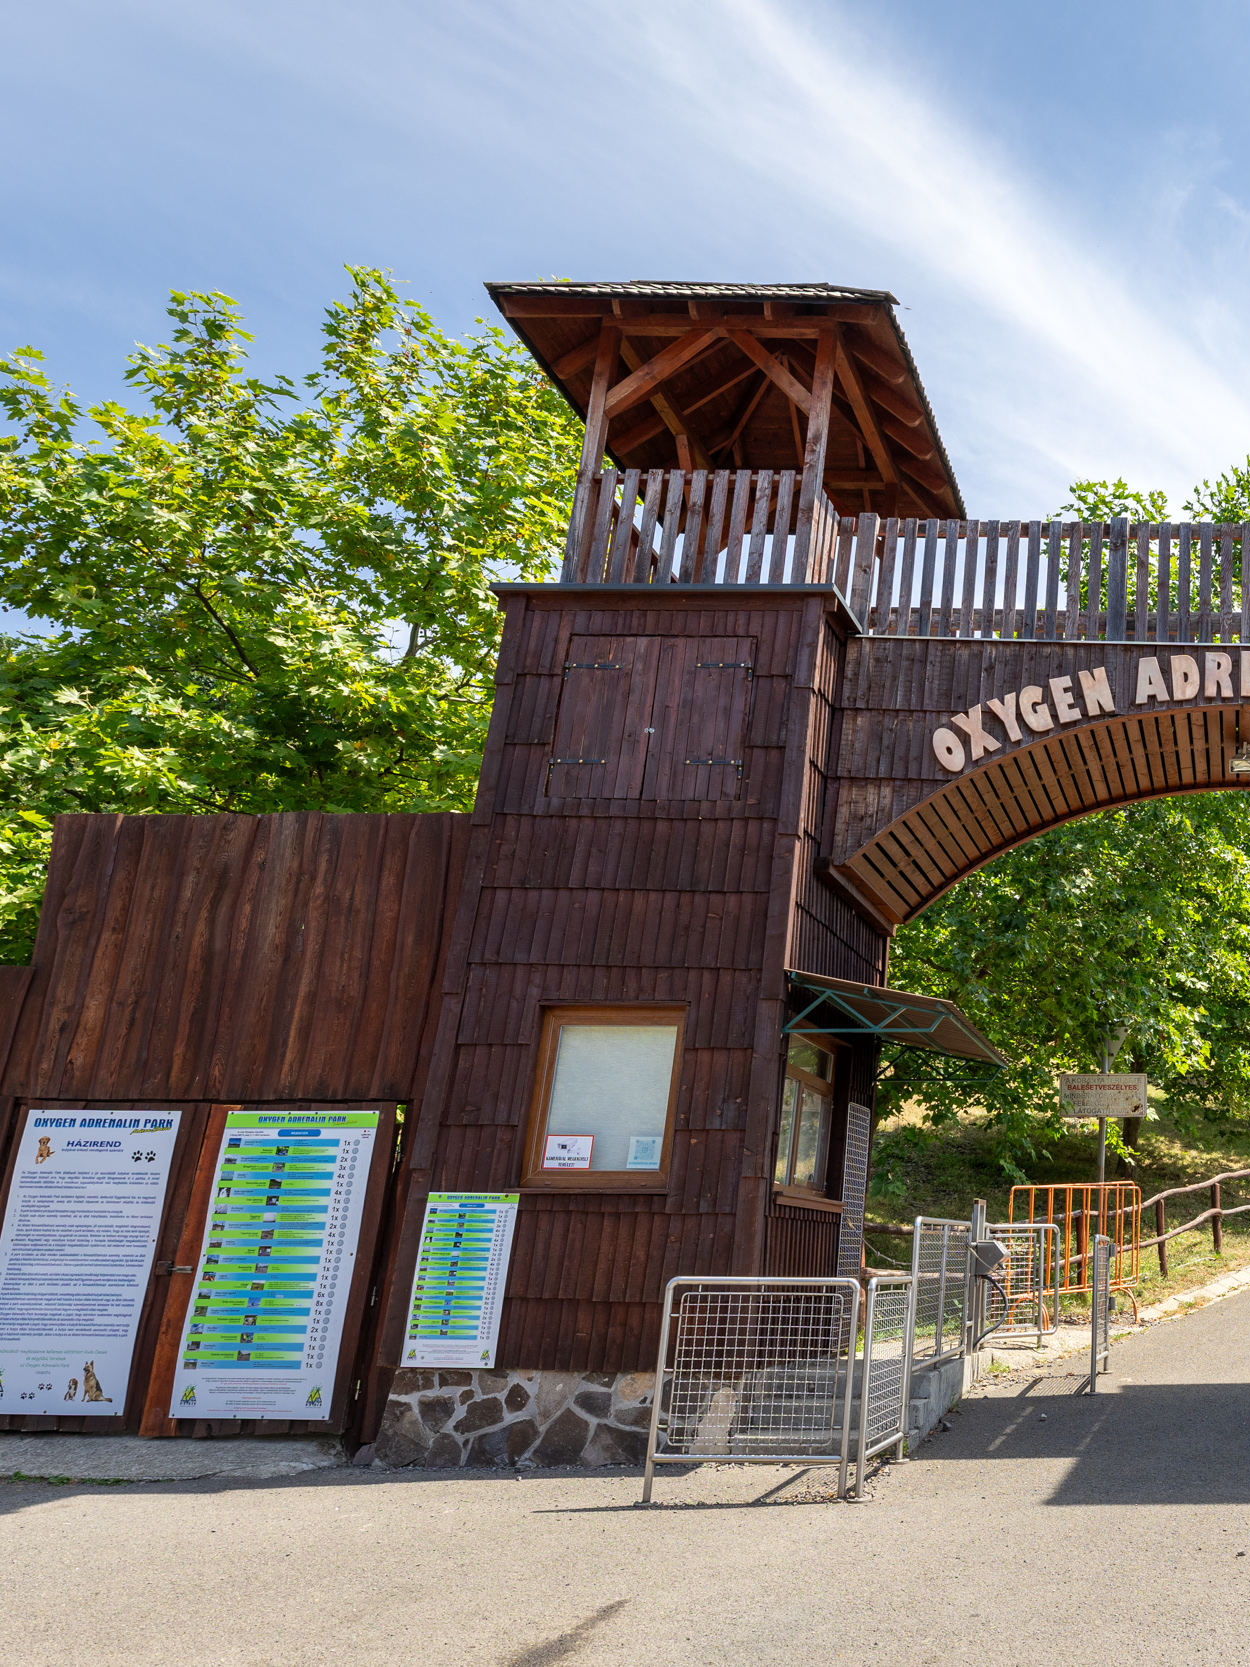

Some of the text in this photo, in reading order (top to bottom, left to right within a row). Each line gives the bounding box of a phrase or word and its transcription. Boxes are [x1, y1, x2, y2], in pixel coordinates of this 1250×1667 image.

[932, 666, 1115, 772] OXYGEN
[34, 1118, 174, 1128] OXYGEN ADRENALIN PARK
[66, 1139, 122, 1147] HÁZIREND
